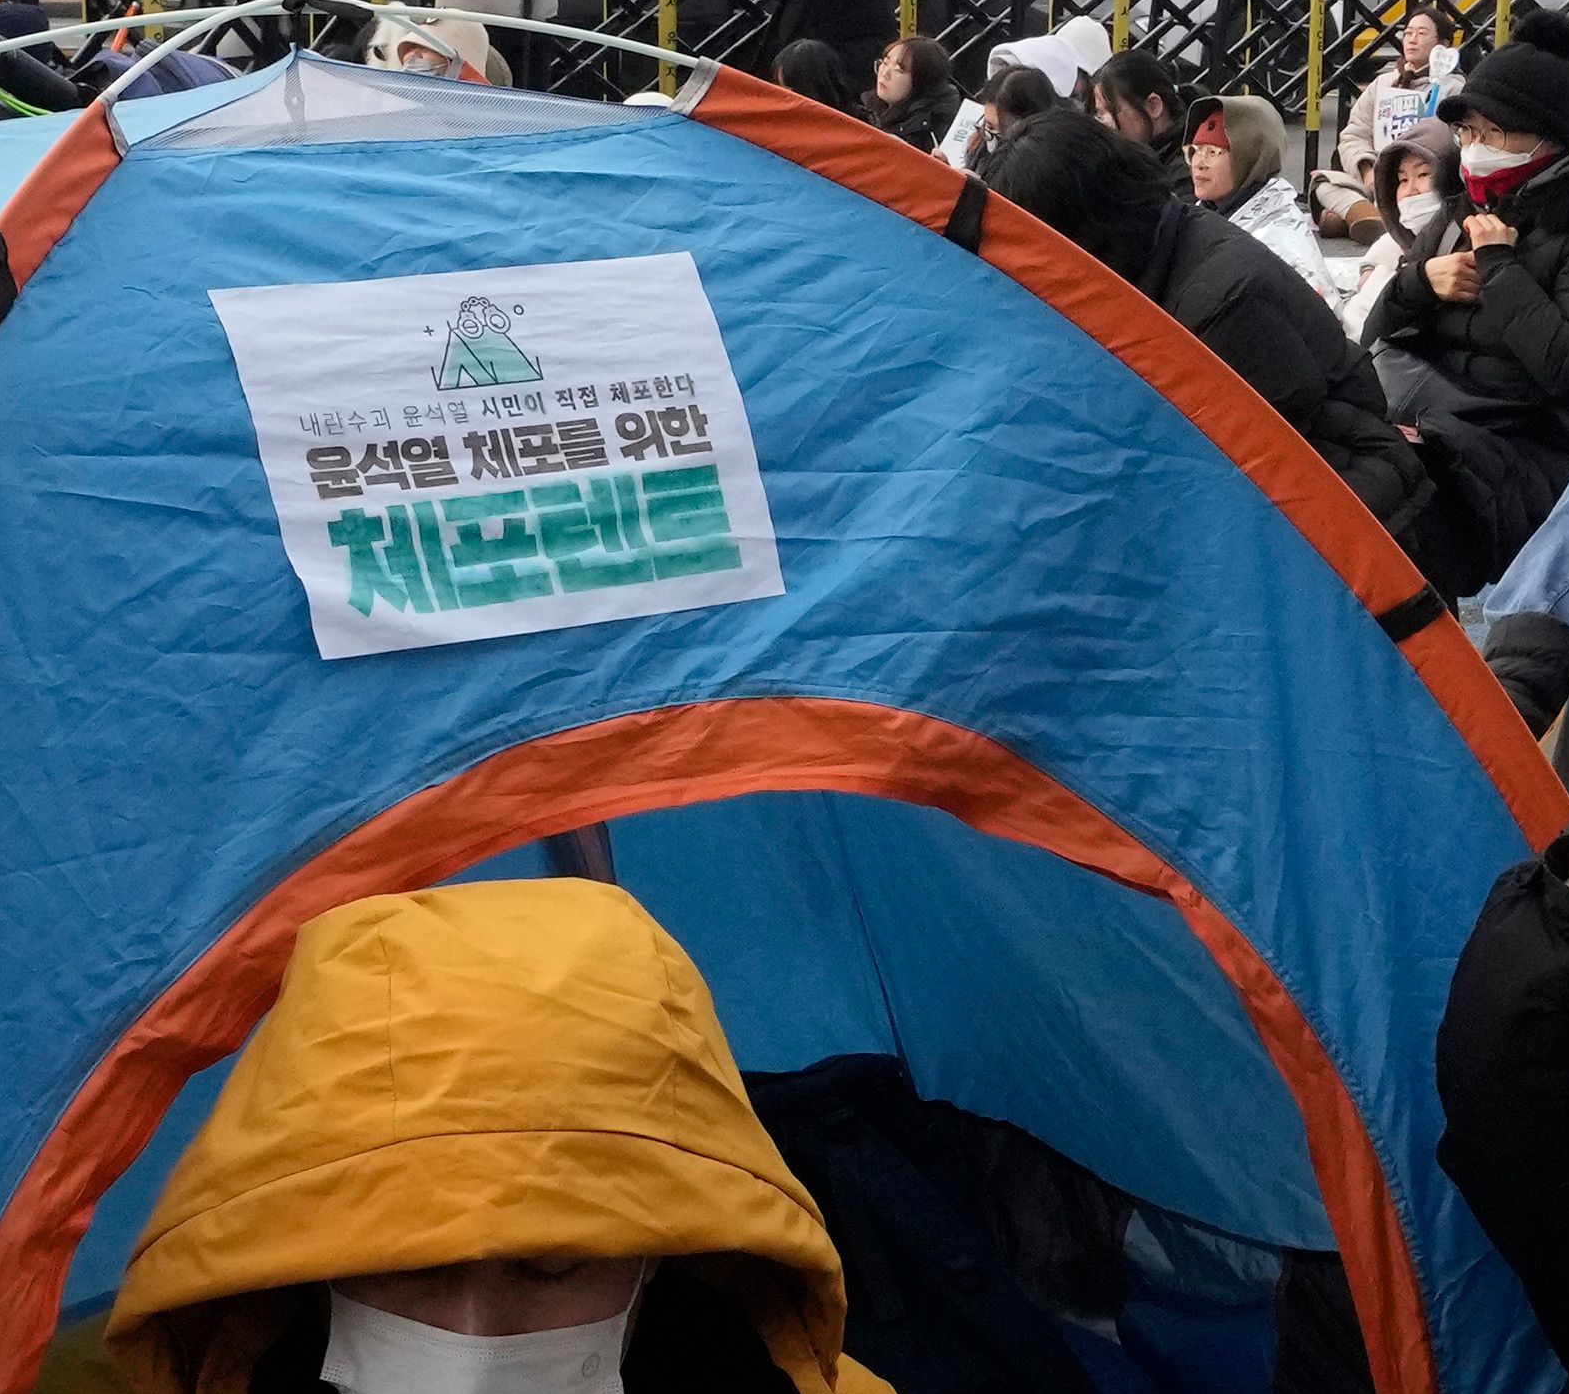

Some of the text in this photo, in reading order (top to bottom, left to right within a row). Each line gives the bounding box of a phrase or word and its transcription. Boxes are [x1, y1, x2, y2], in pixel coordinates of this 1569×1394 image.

[299, 373, 697, 438] 내란수괴 윤석열 시민이 직접 체포한다
[305, 403, 713, 500] 윤석열 체포를 위한
[327, 463, 743, 618] 체포텐트
